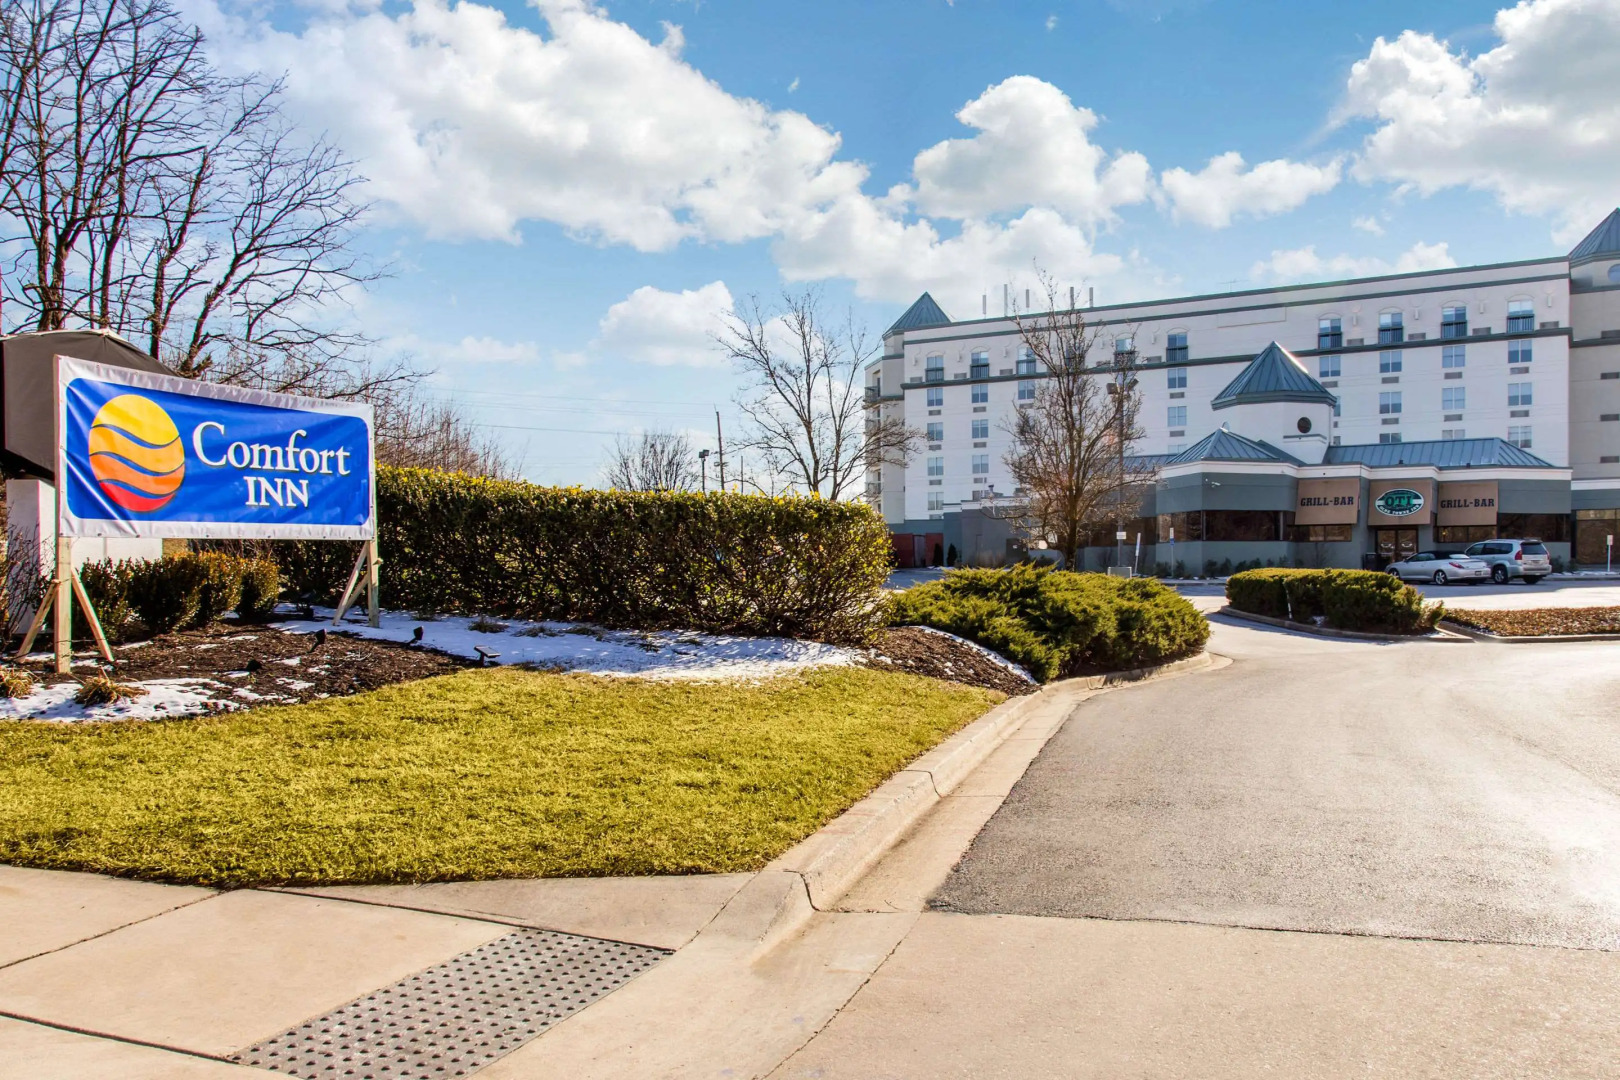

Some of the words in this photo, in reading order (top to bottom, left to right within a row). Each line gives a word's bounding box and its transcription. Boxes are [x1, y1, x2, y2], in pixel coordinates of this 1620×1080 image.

[192, 421, 351, 475] Comfort
[243, 476, 309, 507] INN
[1300, 496, 1354, 507] GRILL-BAR
[1385, 495, 1412, 507] OTI
[1440, 498, 1495, 509] GRILL-BAR
